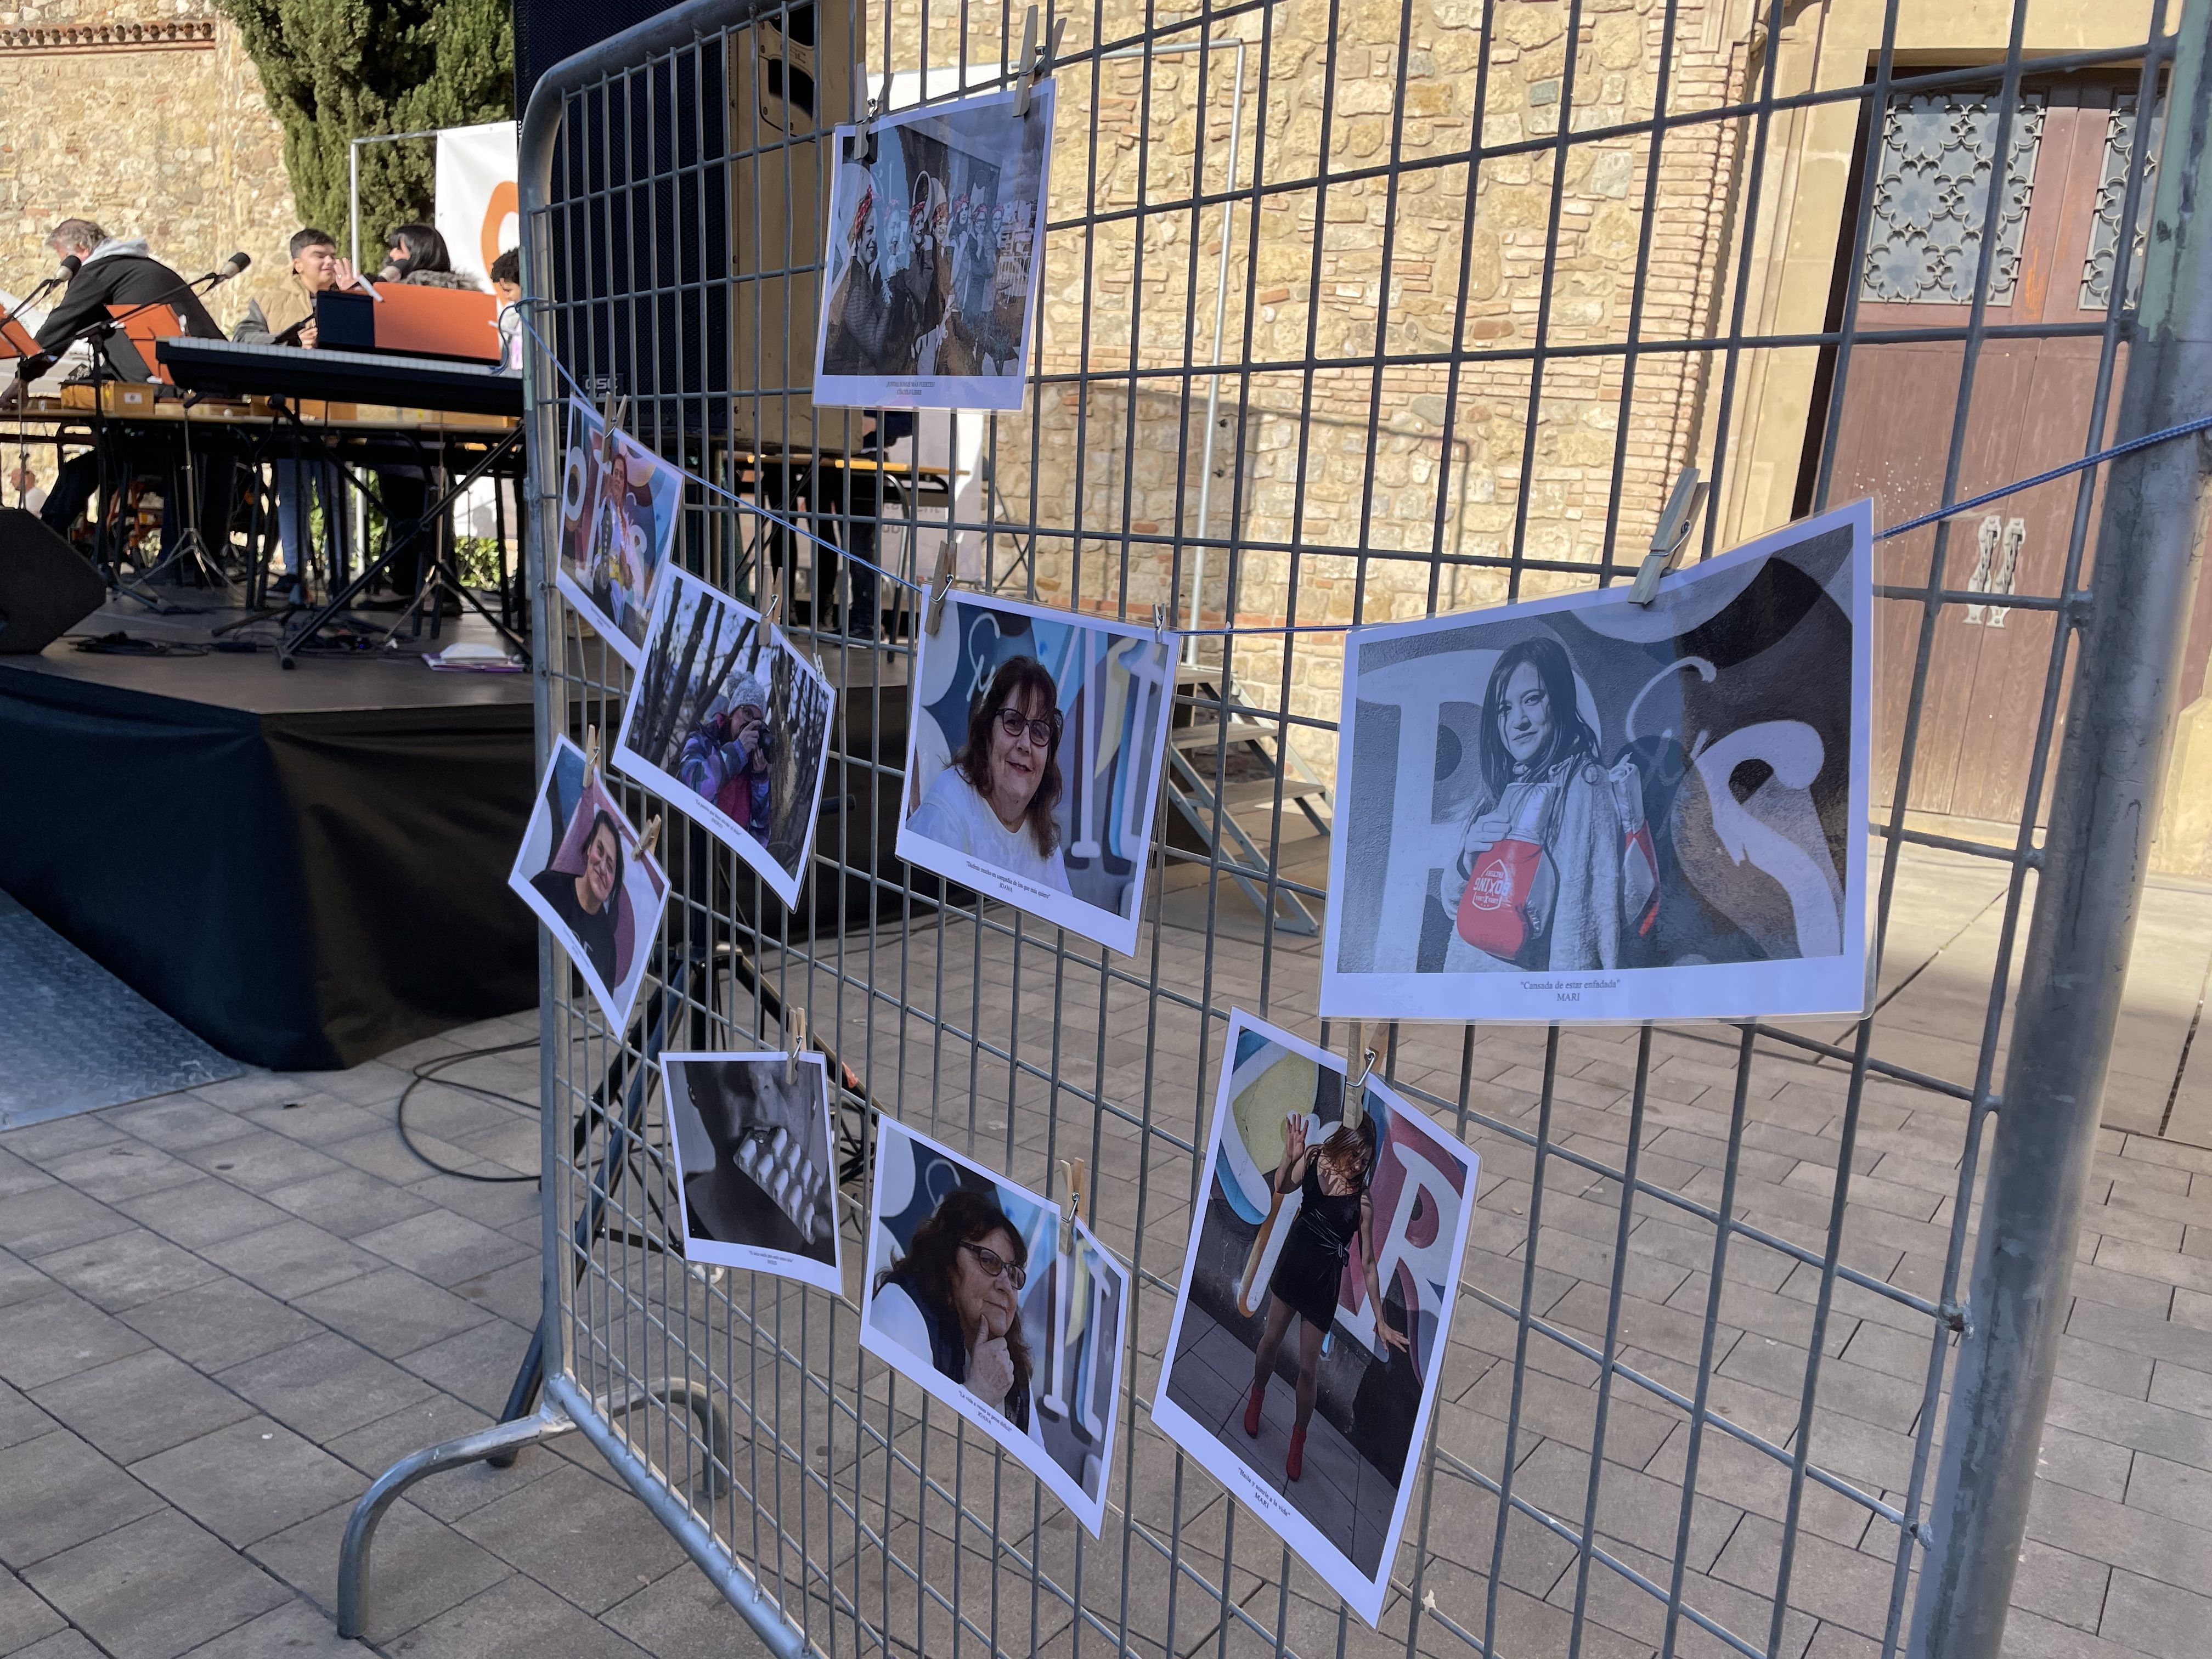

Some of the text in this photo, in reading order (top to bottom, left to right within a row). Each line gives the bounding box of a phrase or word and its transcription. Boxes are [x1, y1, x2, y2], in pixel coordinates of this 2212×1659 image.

[1000, 882, 1013, 893] JOANA
[1473, 877, 1511, 896] BOXING
[1520, 981, 1553, 990] "Cansada
[1555, 981, 1564, 989] de
[1584, 979, 1620, 989] enfadada"
[1557, 993, 1581, 1001] MARI
[978, 1411, 991, 1425] JOANA
[1238, 1467, 1251, 1483] "Baila
[1273, 1499, 1278, 1507] la
[1278, 1505, 1290, 1516] vida"
[1255, 1492, 1269, 1509] MARI
